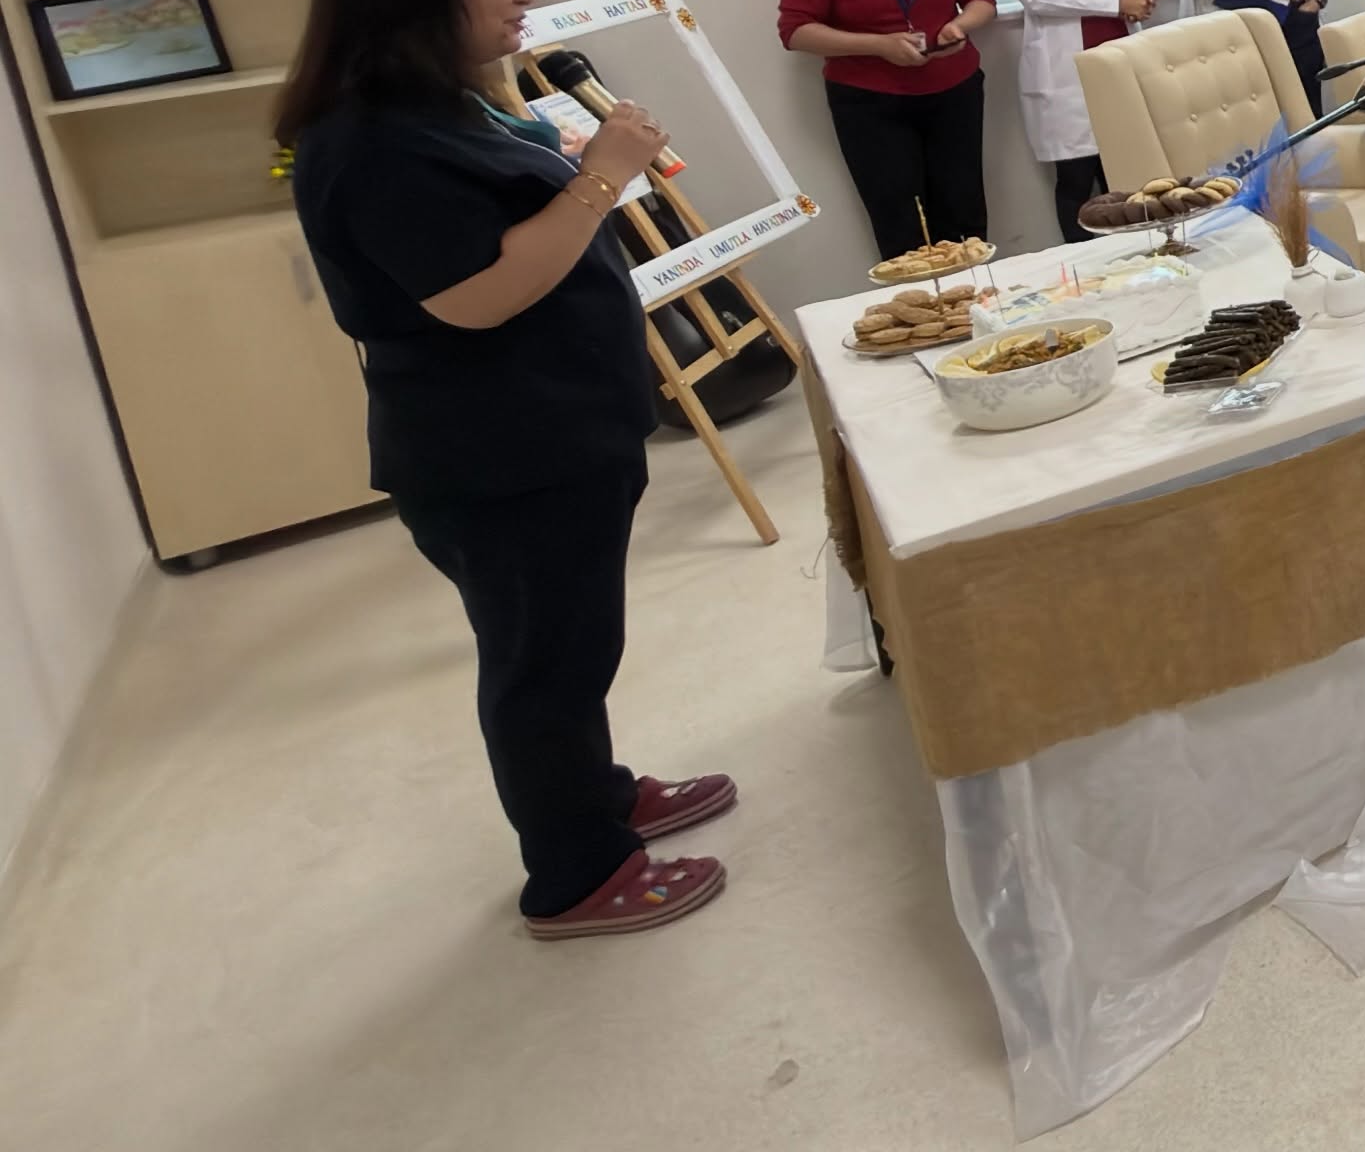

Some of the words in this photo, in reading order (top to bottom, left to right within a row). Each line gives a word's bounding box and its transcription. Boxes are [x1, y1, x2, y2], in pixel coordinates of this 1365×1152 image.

[552, 10, 592, 30] BAKIM
[653, 256, 704, 286] YANINDA
[709, 231, 752, 258] UMUTLA
[752, 206, 801, 236] HAYATINDA
